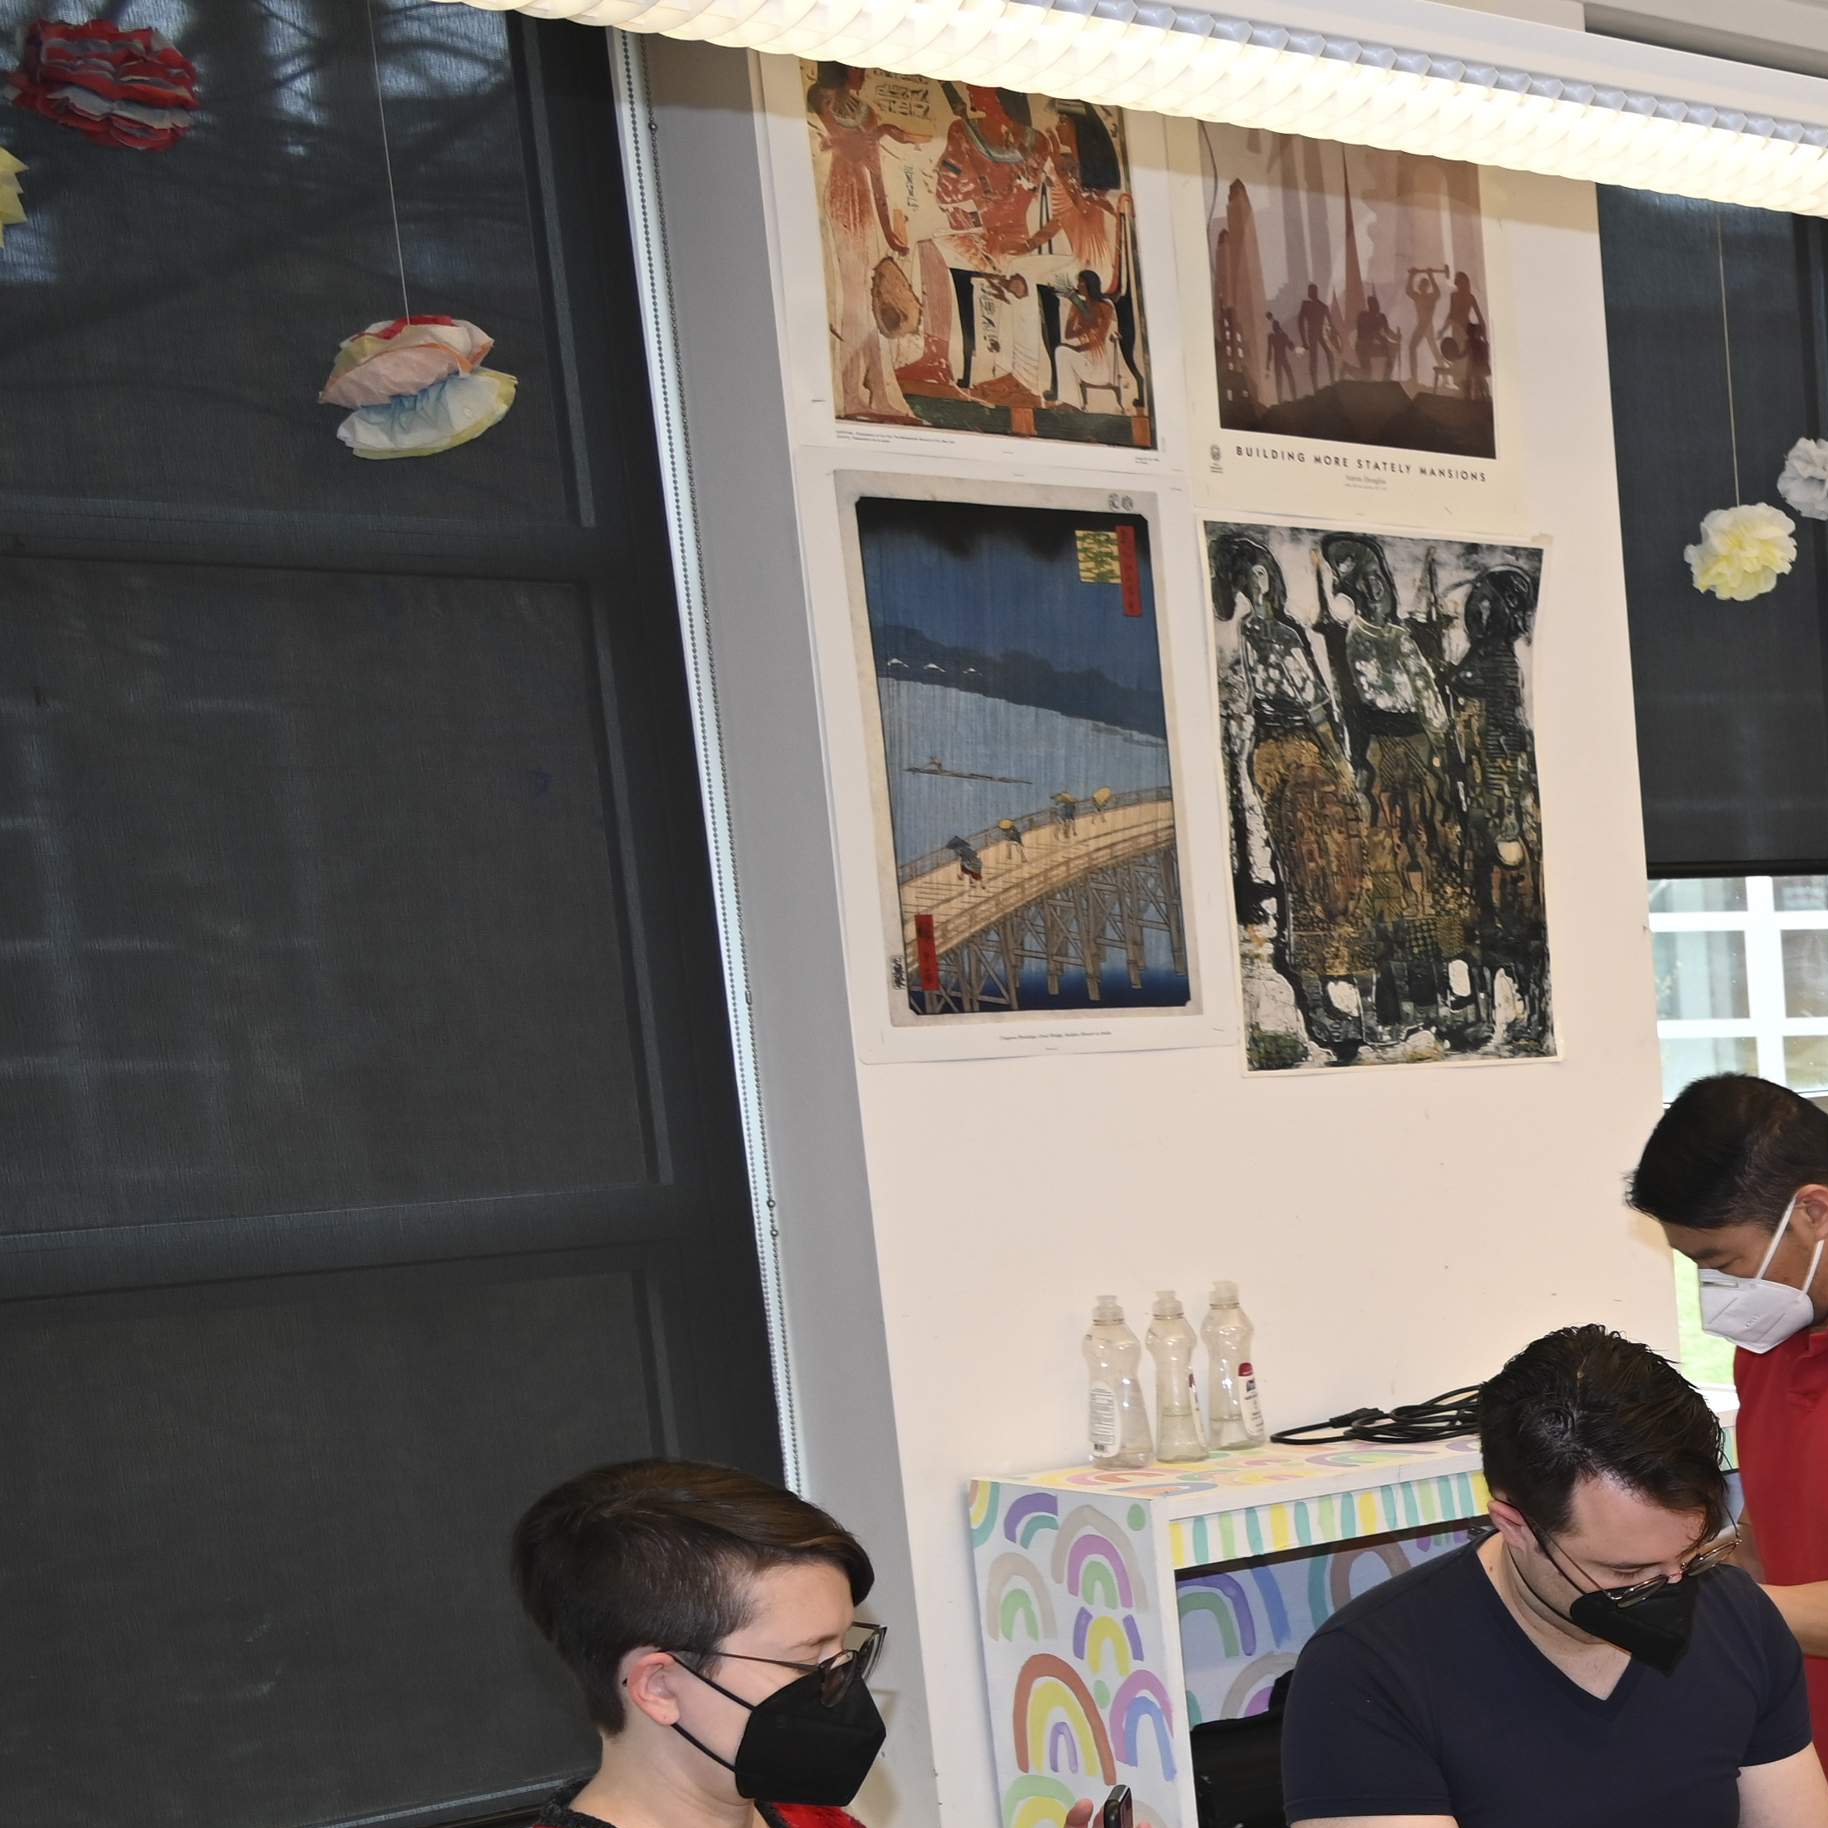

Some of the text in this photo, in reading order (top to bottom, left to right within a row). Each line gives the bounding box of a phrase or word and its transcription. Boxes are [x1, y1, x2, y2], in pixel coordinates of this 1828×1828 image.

[1235, 446, 1487, 483] BUILDING MORE STATELY MANSIONS
